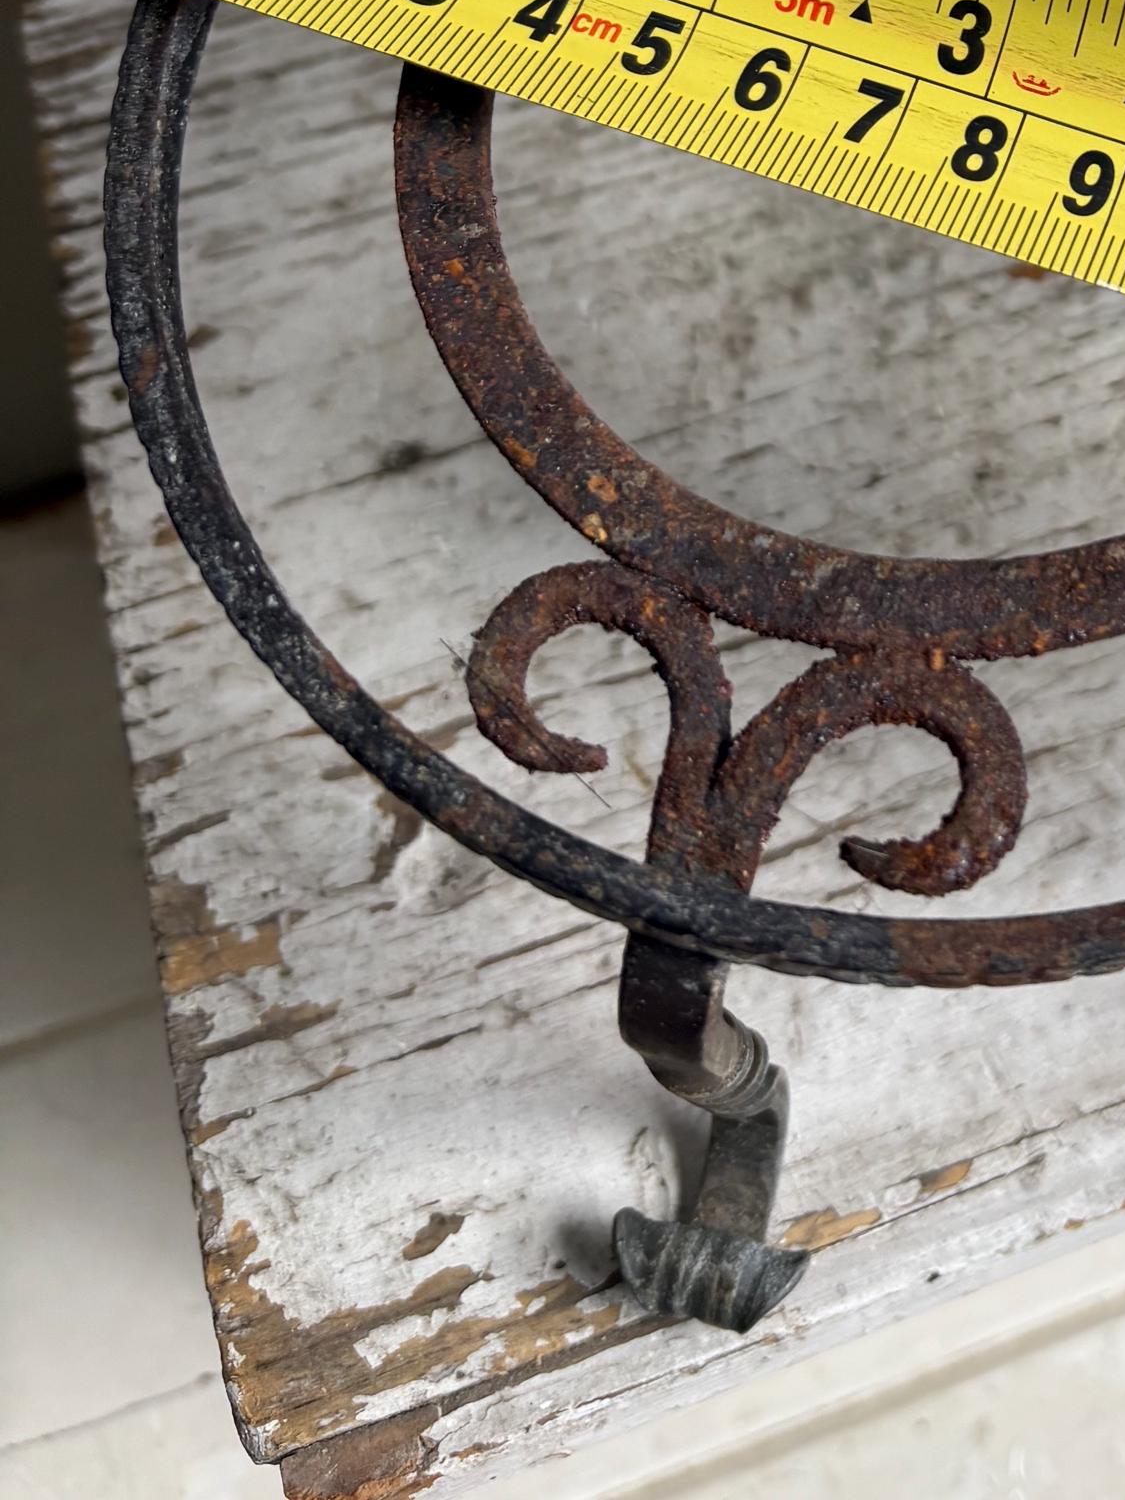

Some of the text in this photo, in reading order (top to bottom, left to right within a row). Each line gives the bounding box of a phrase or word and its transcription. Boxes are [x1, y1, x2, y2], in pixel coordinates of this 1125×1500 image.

[937, 0, 992, 76] 3
[570, 12, 622, 44] cm
[621, 11, 685, 76] 5
[734, 47, 791, 111] 6
[843, 78, 905, 144] 7
[950, 115, 1009, 182] 8
[1062, 150, 1115, 217] 9
